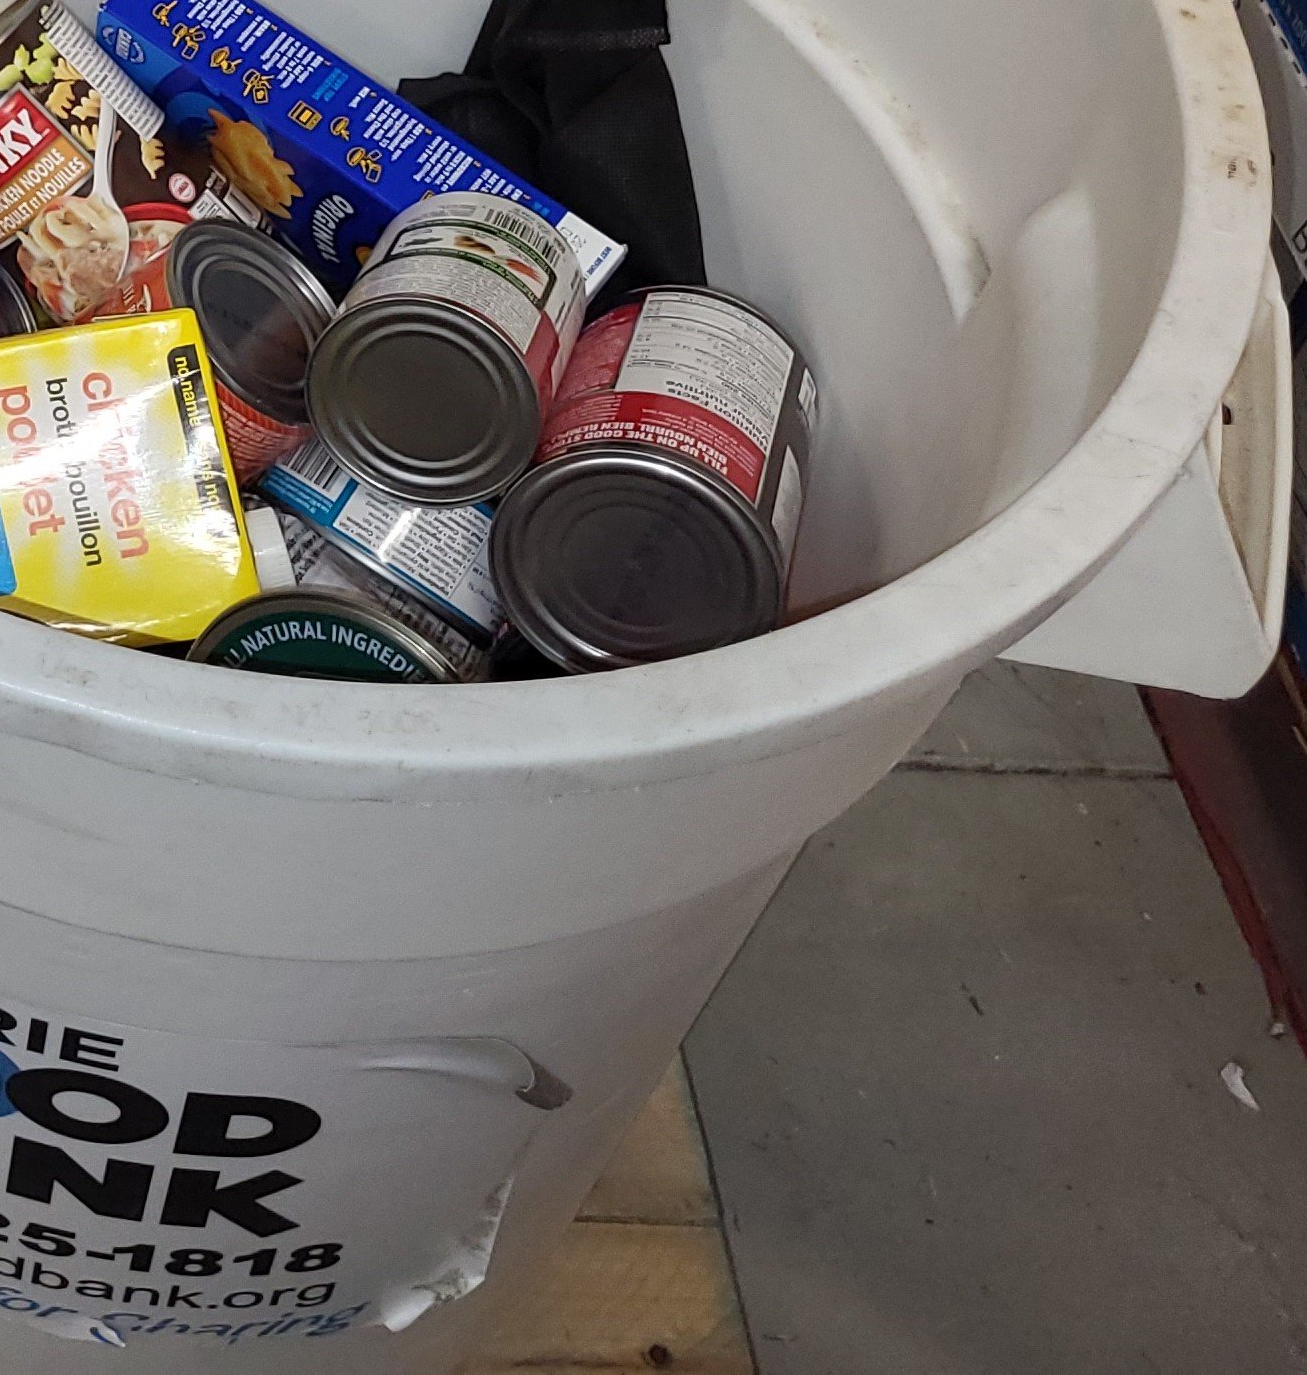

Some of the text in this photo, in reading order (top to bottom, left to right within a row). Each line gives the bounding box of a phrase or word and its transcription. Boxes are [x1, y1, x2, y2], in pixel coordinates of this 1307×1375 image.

[22, 147, 66, 191] NOODLE
[36, 156, 87, 202] NOUILLES
[313, 194, 353, 264] ORIGINAL
[664, 380, 729, 409] nutritive
[666, 387, 711, 408] Facts
[583, 428, 624, 440] GOOD
[600, 421, 636, 431] BIEN
[625, 429, 655, 443] THE
[656, 435, 678, 449] ON
[679, 444, 700, 459] UP
[696, 440, 729, 467] BIEN
[702, 455, 729, 476] FILL
[65, 462, 103, 567] bouillon
[239, 620, 328, 658] NATURAL
